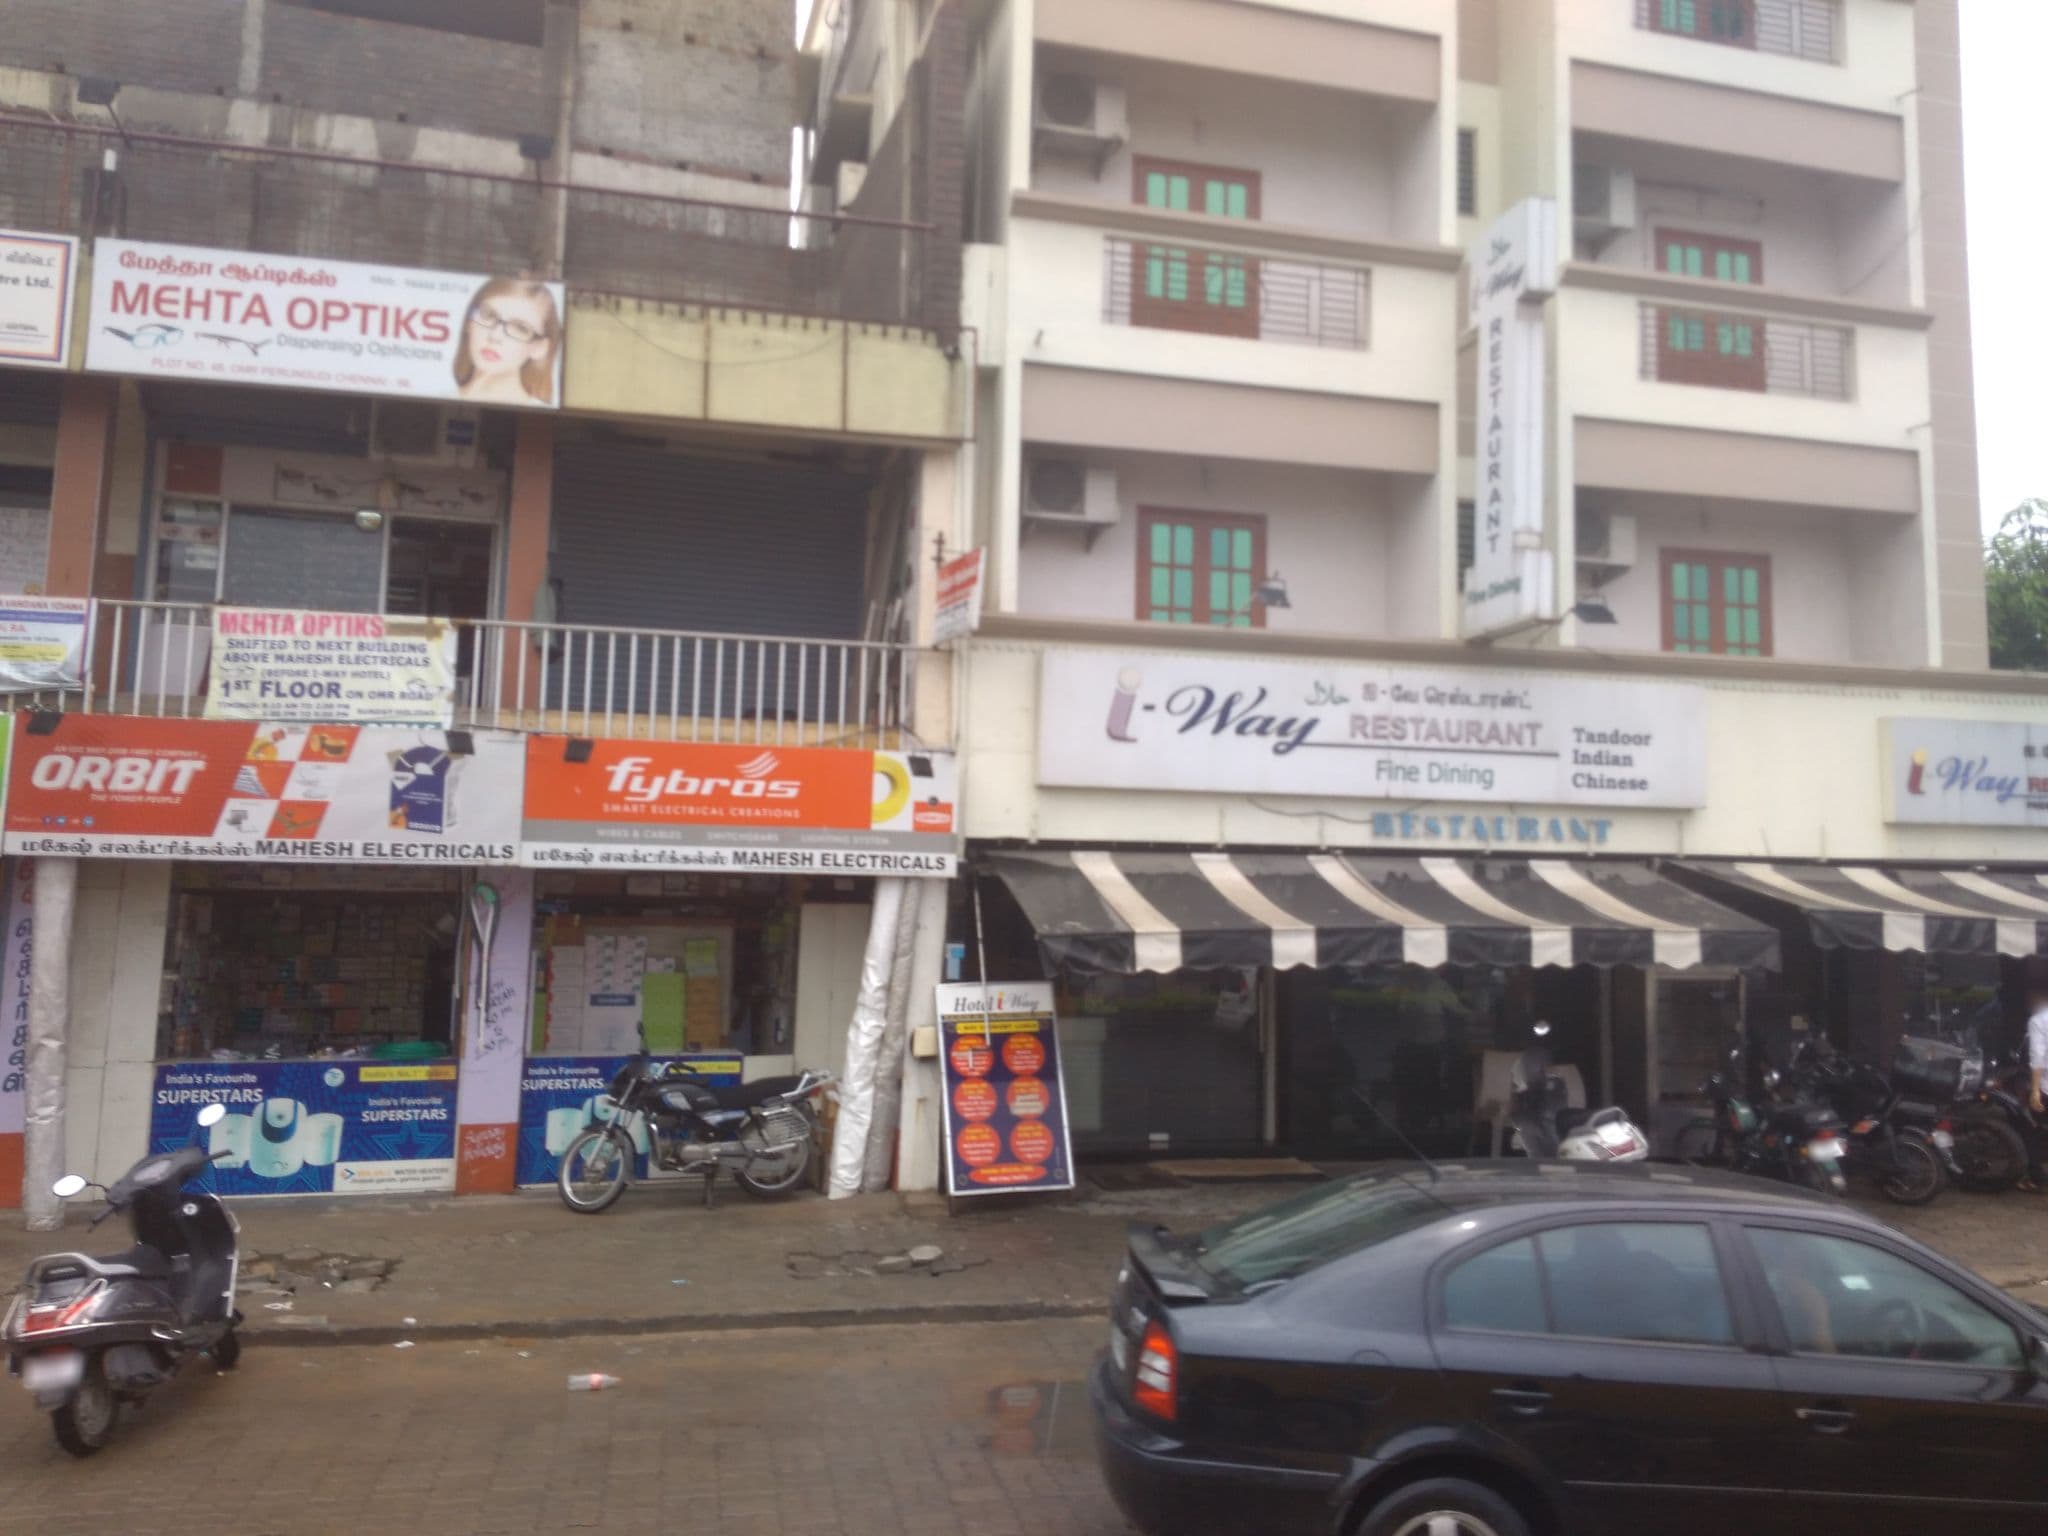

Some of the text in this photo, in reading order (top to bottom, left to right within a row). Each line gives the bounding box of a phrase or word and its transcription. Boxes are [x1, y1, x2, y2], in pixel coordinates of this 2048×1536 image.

[110, 279, 451, 344] MEHTA OPTIKS
[277, 333, 443, 362] Dispensing Opticians
[1486, 317, 1504, 554] RESTAURANT
[219, 611, 385, 638] MEHTA OPTIKS
[226, 638, 428, 653] SHIFTED TO NEXT BUILDING
[223, 652, 432, 667] ABOVE MAHESH ELECTRICALS
[259, 681, 341, 699] FLOOR
[1350, 714, 1543, 747] RESTAURANT
[1571, 727, 1653, 747] Tandoor
[1571, 750, 1634, 768] Indian
[31, 753, 207, 794] ORBIT
[1375, 759, 1495, 791] Fine Dining
[1571, 772, 1649, 791] Chinese
[602, 803, 801, 819] SMART ELECTRICAL CREATIONS
[1371, 811, 1613, 846] RESTAURANT
[254, 840, 354, 858] MAHESH
[362, 842, 515, 860] ELECTRICALS
[732, 850, 814, 868] MAHESH
[820, 853, 947, 872] ELECTRICALS
[166, 1072, 258, 1084] India's Favourite
[521, 1077, 606, 1092] SUPERSTARS
[157, 1088, 263, 1105] SUPERSTARS
[361, 1108, 448, 1122] SUPERSTARS
